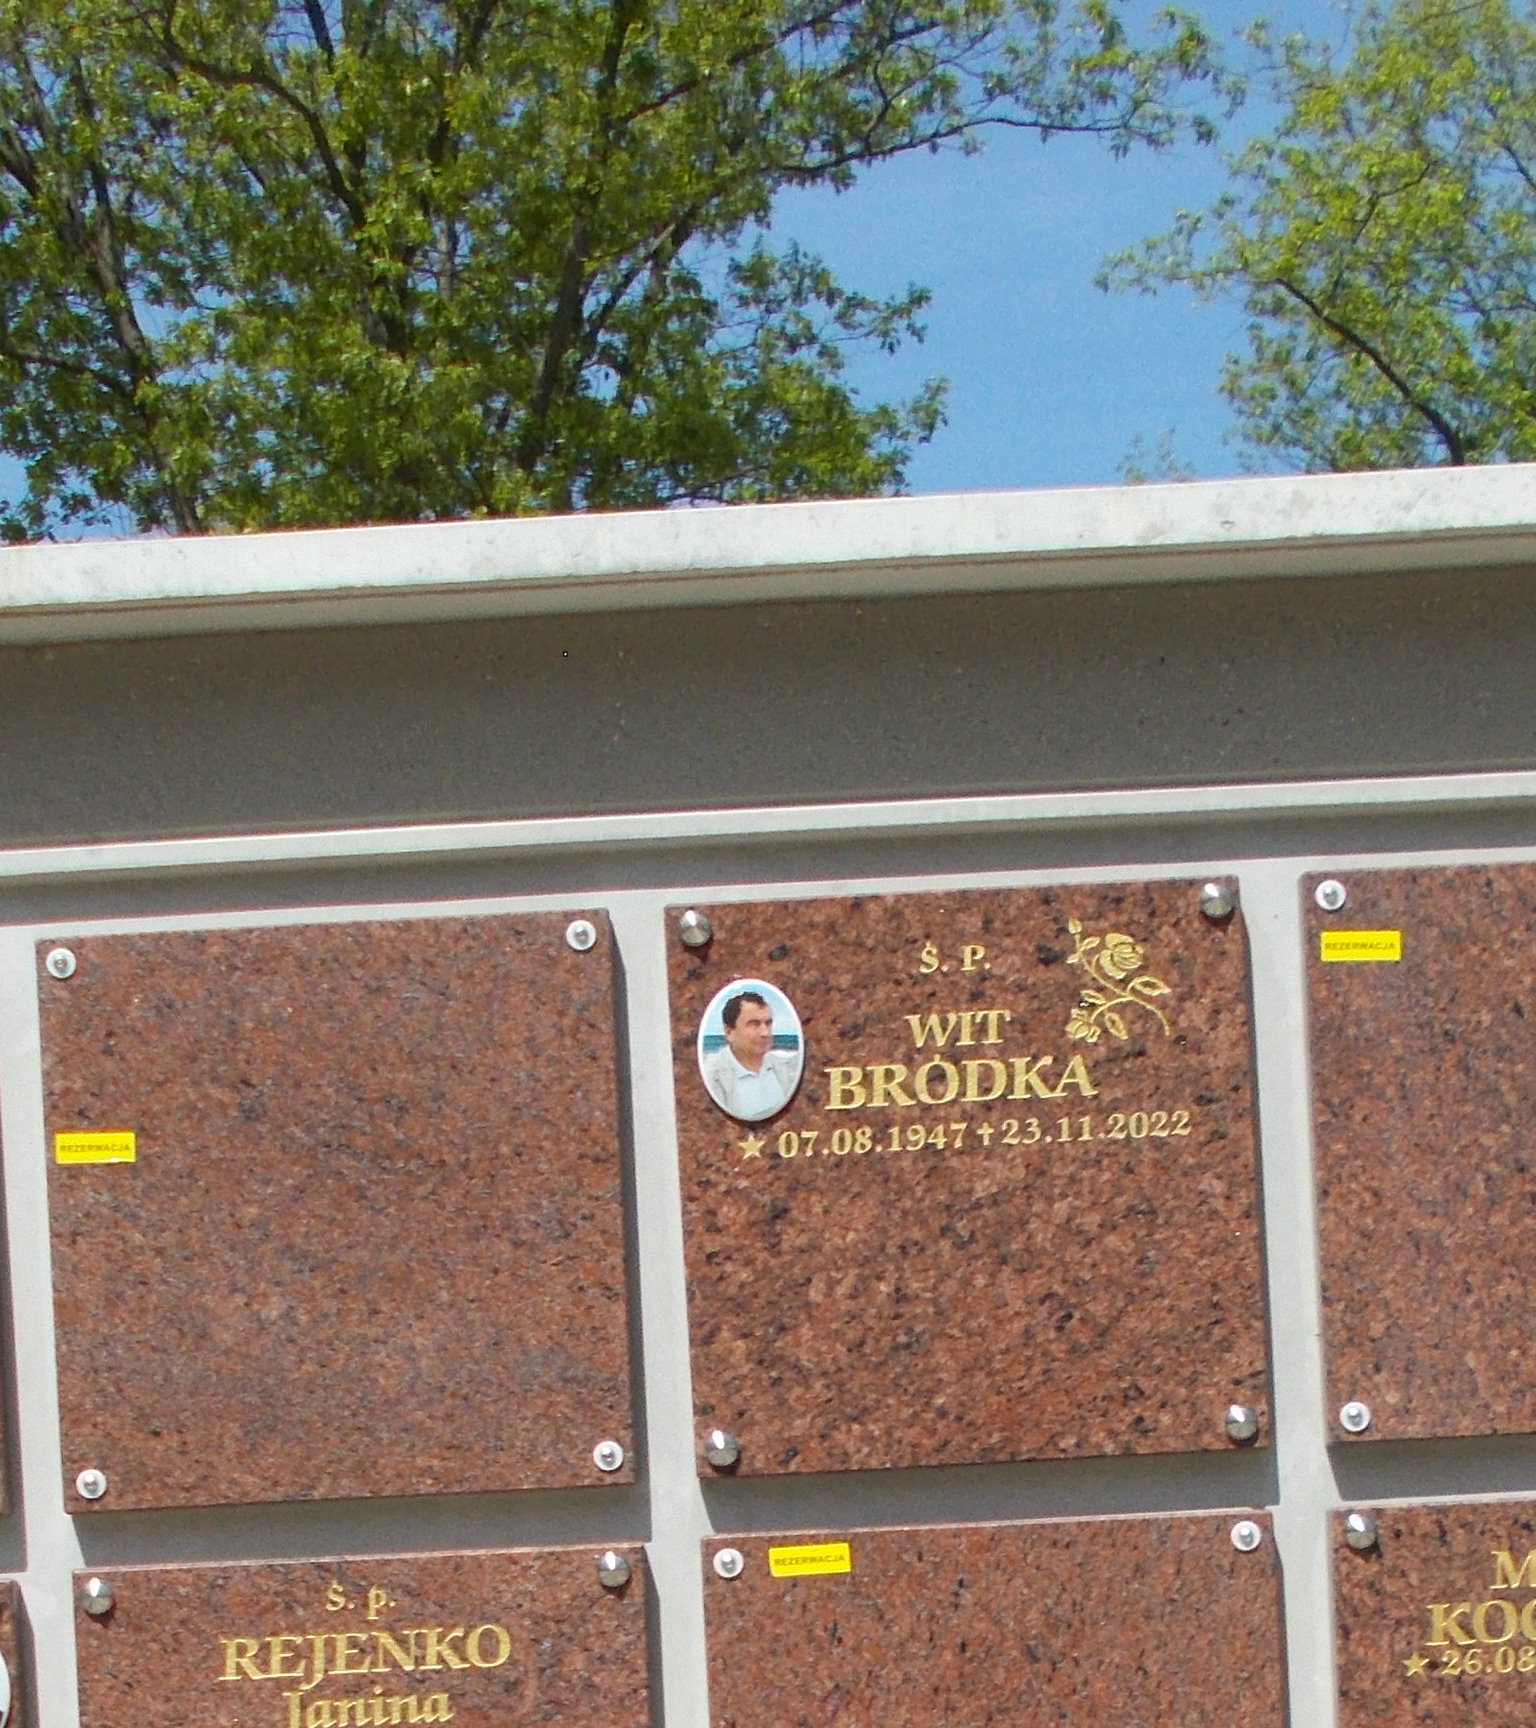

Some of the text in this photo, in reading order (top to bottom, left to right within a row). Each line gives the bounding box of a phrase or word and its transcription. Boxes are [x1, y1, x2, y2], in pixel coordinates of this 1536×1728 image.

[960, 944, 991, 971] P.
[905, 1009, 1012, 1048] WIT
[823, 1053, 1098, 1111] BRÓDKA
[60, 1143, 130, 1153] REZERWACJA
[778, 1110, 1192, 1159] 07.08.1947 23.11.2022
[774, 1555, 845, 1566] REZERWACJA
[218, 1623, 512, 1690] REJENKO
